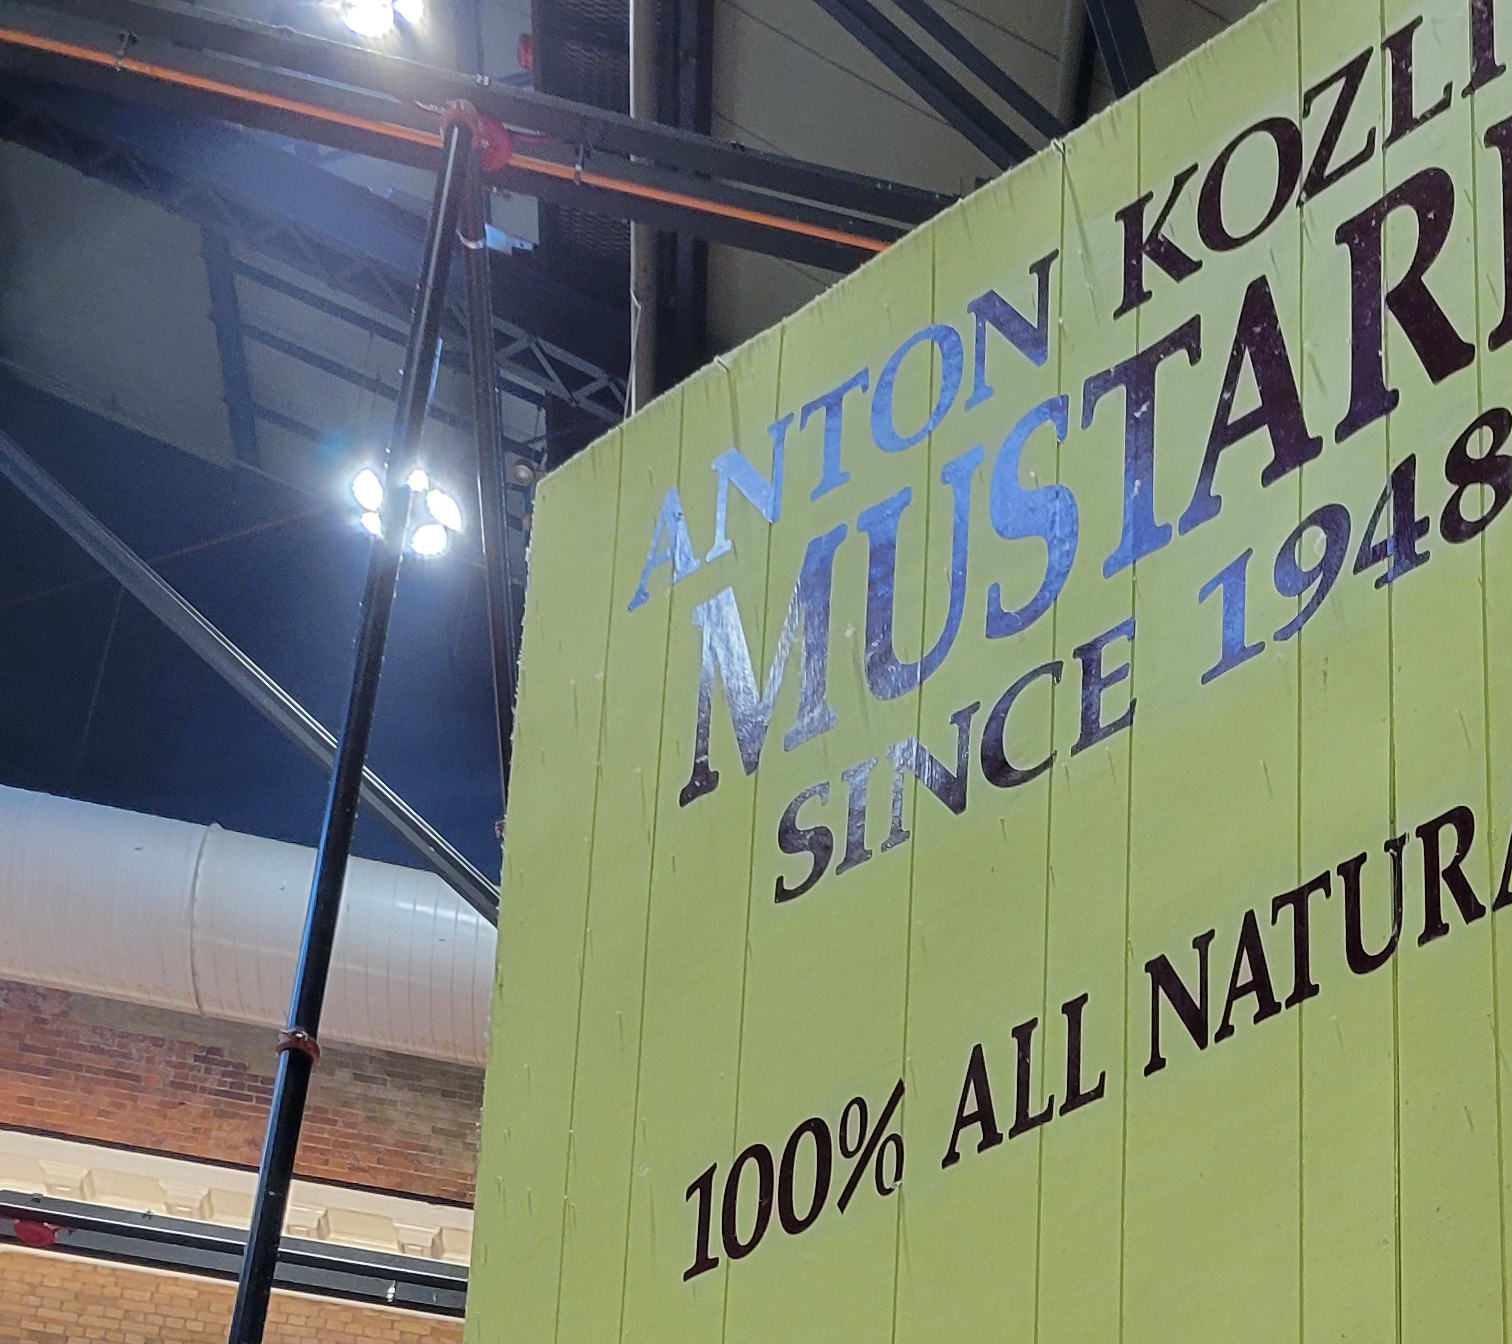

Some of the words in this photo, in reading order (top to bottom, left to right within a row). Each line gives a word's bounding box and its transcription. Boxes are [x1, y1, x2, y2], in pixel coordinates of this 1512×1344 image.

[626, 249, 1059, 614] ANTON
[772, 618, 1138, 905] SINCE
[682, 1081, 906, 1283] 100%
[942, 993, 1108, 1169] ALL
